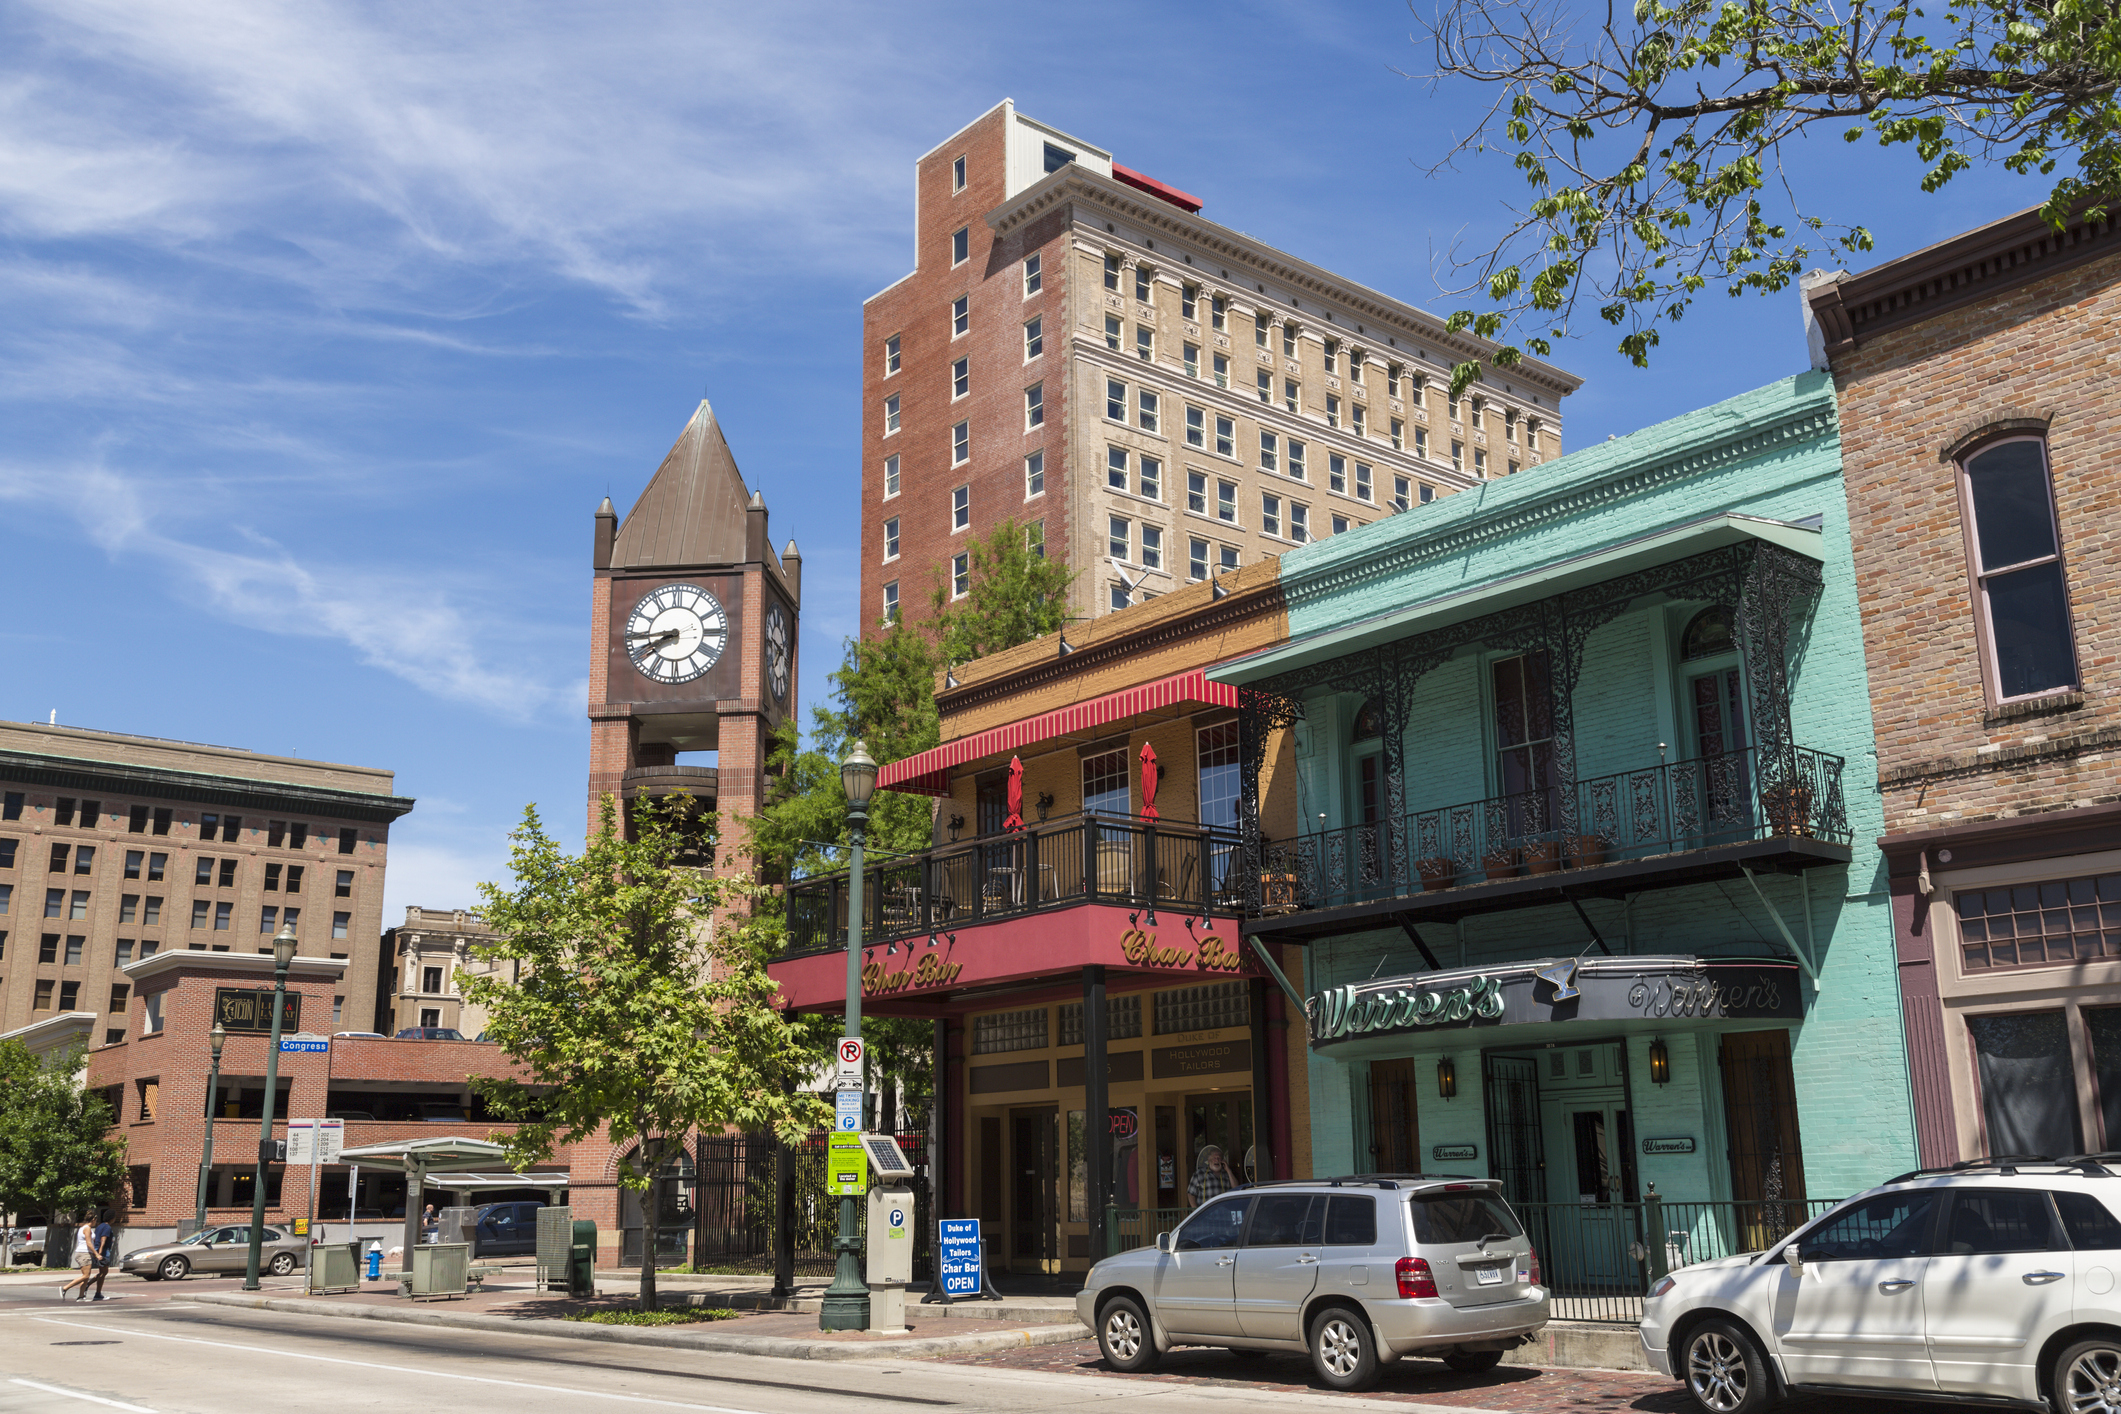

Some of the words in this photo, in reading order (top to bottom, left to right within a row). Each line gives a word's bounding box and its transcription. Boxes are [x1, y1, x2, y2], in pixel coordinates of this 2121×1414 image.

[1121, 929, 1193, 964] Char
[862, 962, 914, 992] Char
[915, 952, 963, 983] Bar
[1630, 973, 1781, 1009] Warren's
[234, 1002, 254, 1020] ICON
[286, 1003, 293, 1011] &
[1309, 975, 1505, 1039] Warren's
[1178, 1033, 1204, 1043] DUKE
[1208, 1031, 1221, 1040] OF
[282, 1041, 326, 1052] Congress
[1170, 1047, 1230, 1060] HOLLYWOOD
[1180, 1060, 1220, 1071] TAILORS
[1643, 1141, 1685, 1151] Warren's
[1434, 1148, 1468, 1157] Warren's
[947, 1224, 963, 1232] Duke
[943, 1236, 977, 1246] Hollywood
[949, 1249, 971, 1257] Tailors
[942, 1263, 962, 1273] Char
[964, 1263, 979, 1273] Bar
[947, 1277, 974, 1290] OPEN
